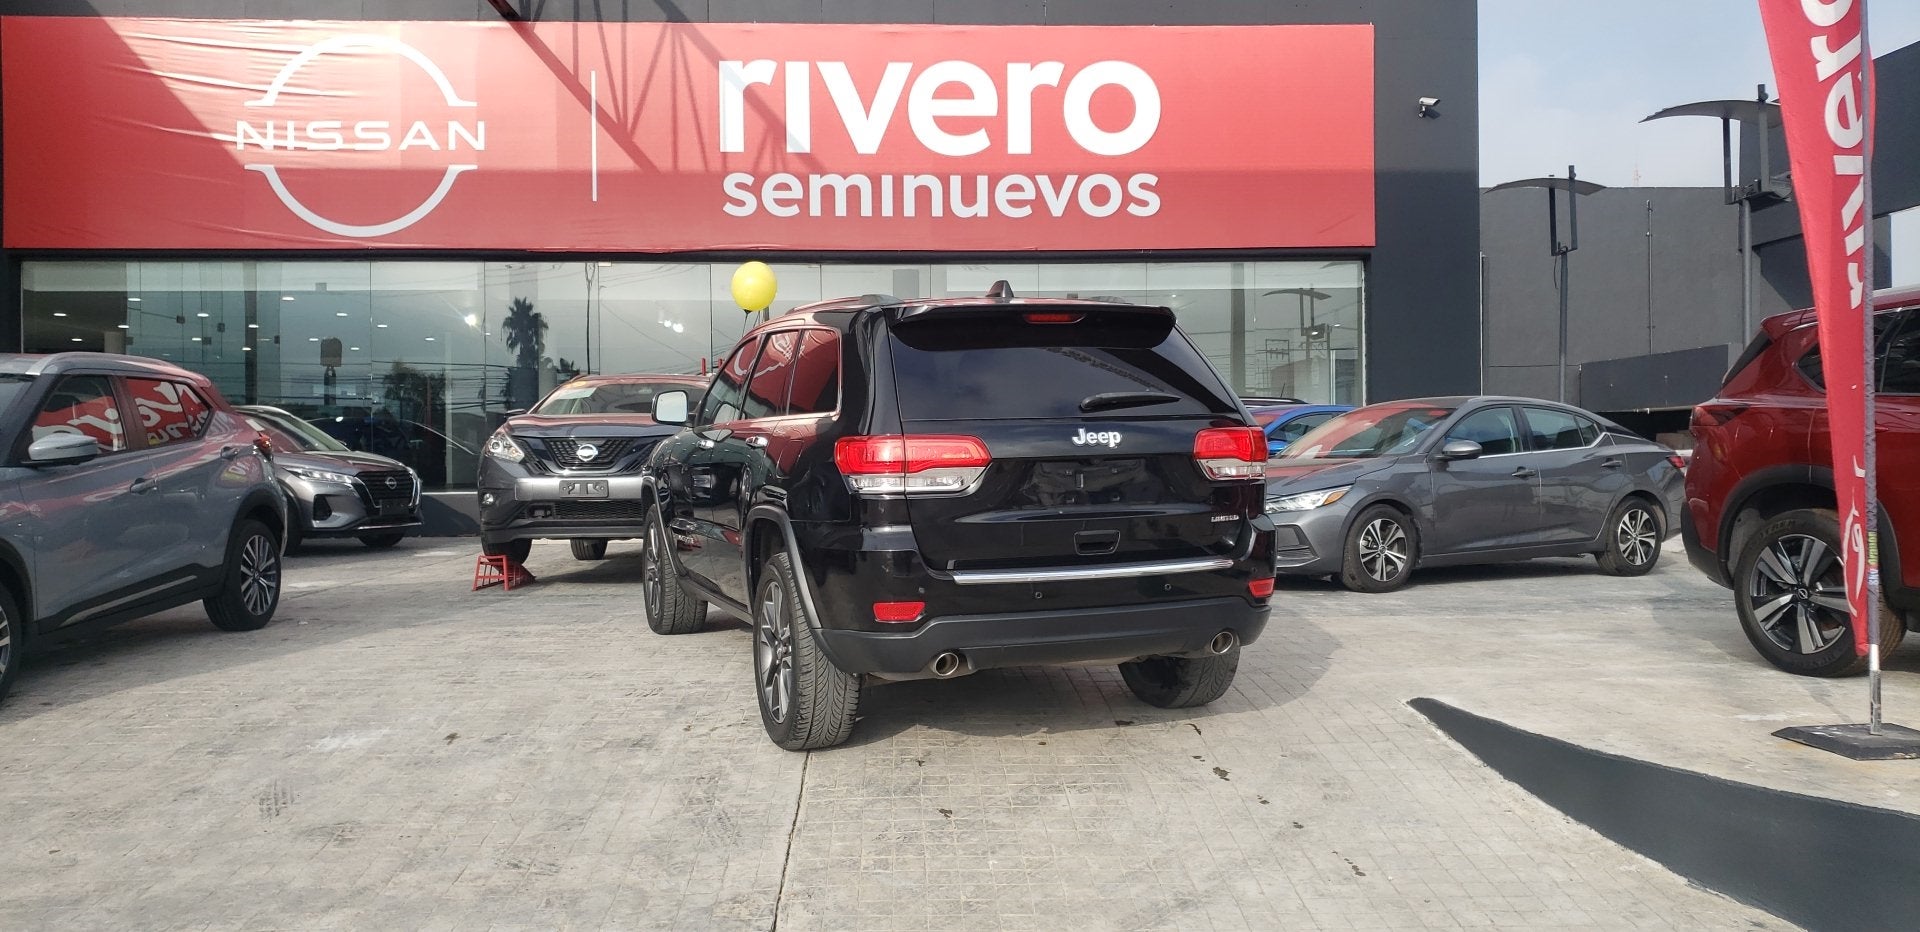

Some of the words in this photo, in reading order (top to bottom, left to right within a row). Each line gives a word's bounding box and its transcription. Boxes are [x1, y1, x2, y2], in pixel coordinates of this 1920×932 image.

[719, 60, 1161, 156] rivero
[236, 120, 486, 150] NISSAN
[722, 172, 1161, 217] seminuevos
[1071, 427, 1121, 448] Jeep
